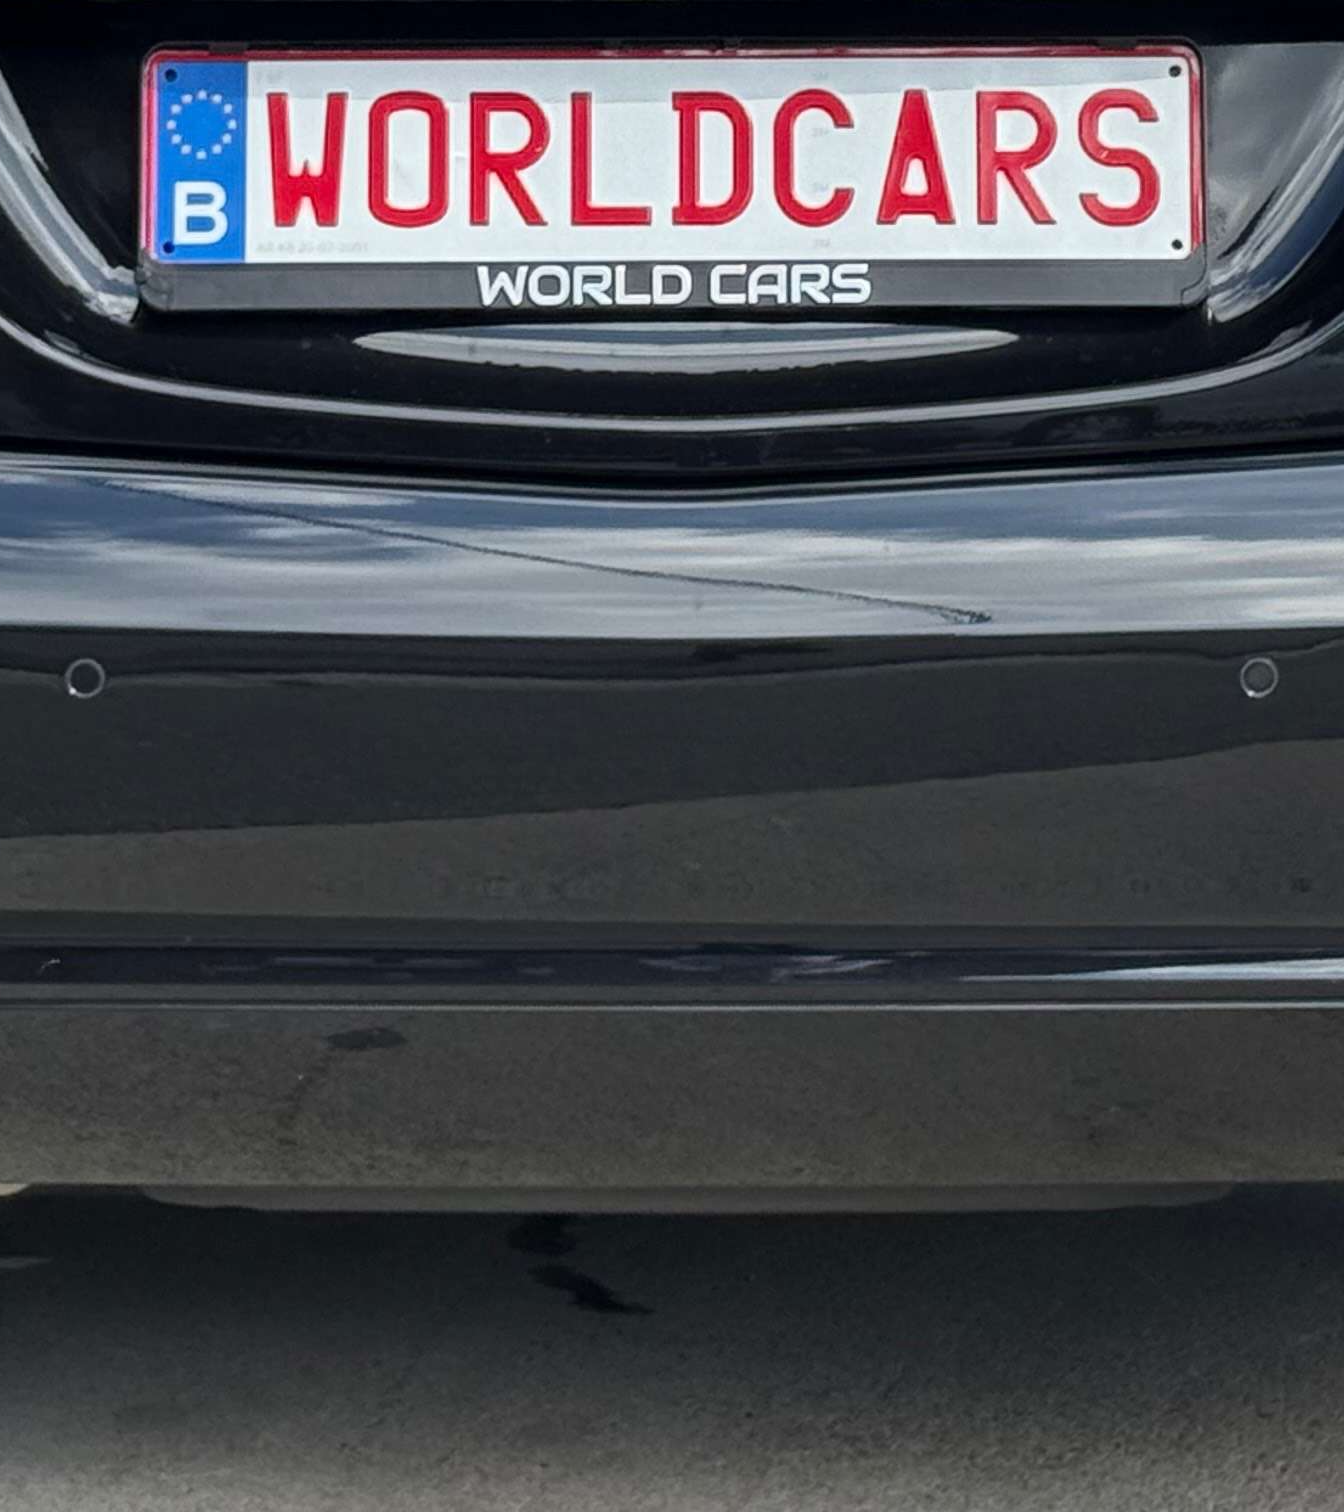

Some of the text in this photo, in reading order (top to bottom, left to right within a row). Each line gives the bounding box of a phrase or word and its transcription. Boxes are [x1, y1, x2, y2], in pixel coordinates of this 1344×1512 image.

[173, 89, 1161, 245] B WORLDCARS
[476, 264, 872, 307] WORLD CARS
